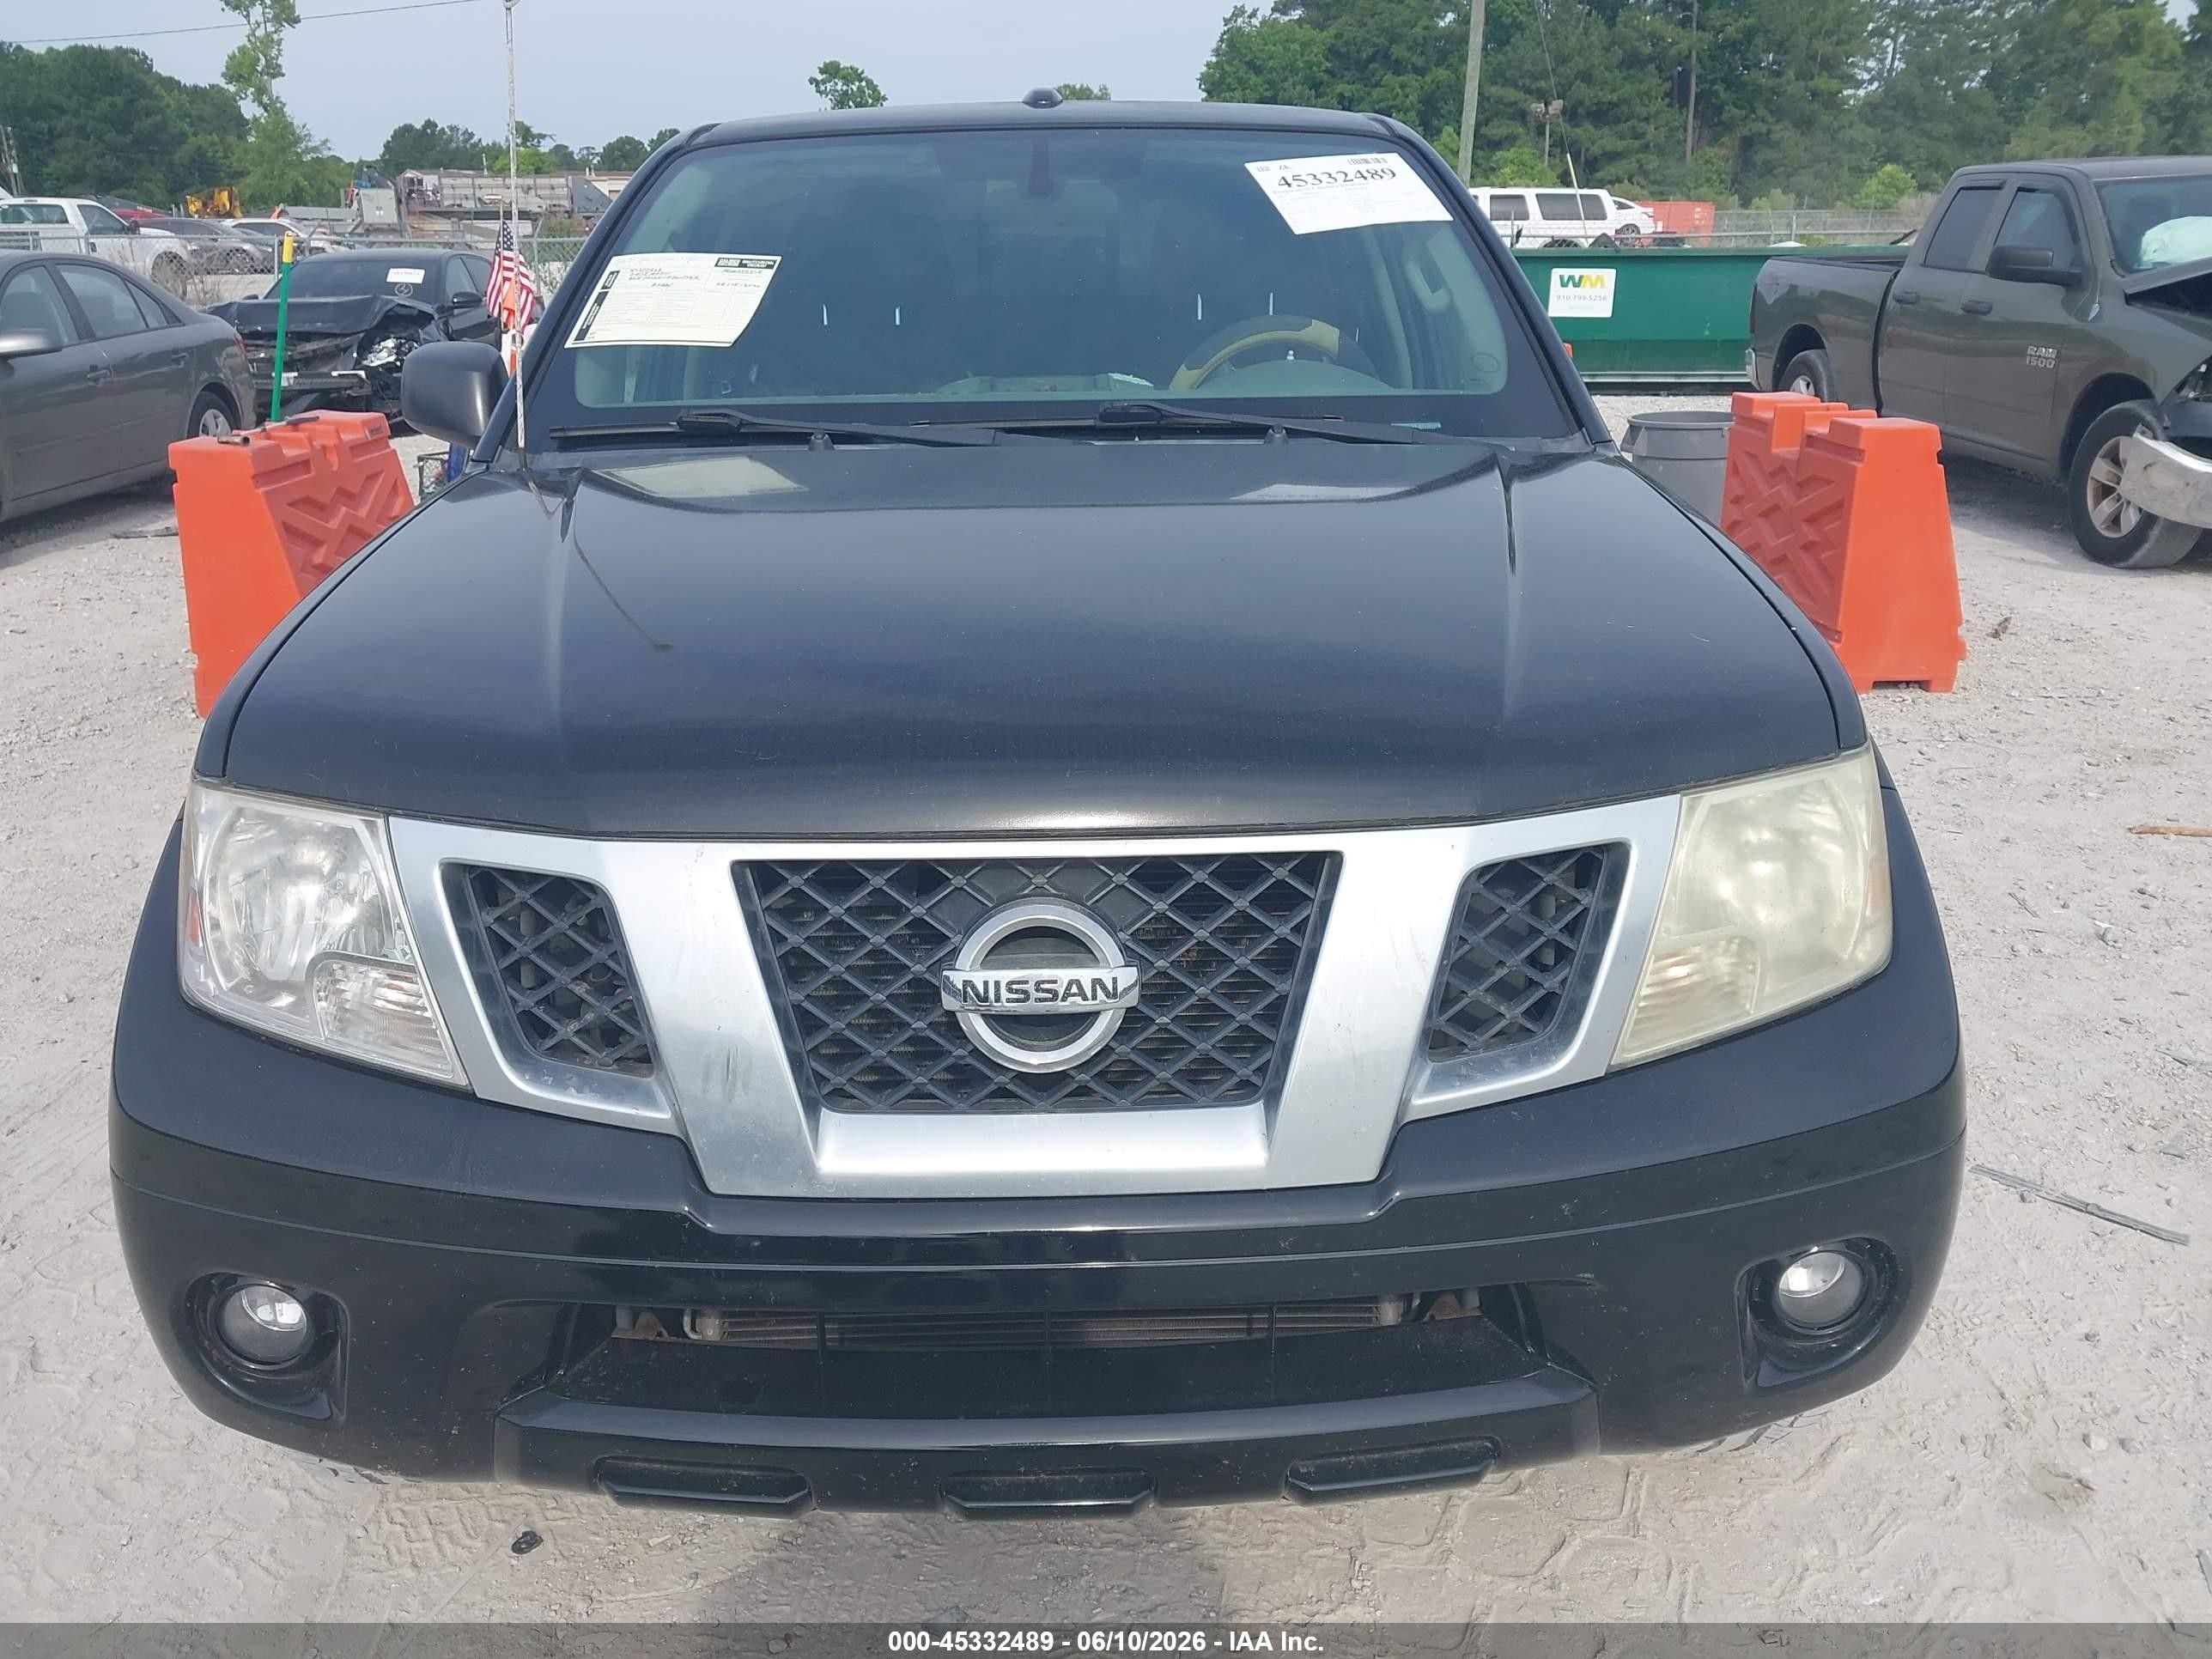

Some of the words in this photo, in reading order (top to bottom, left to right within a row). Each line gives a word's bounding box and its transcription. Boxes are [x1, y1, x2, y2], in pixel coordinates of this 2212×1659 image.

[1278, 167, 1397, 188] 45332489
[1559, 274, 1606, 289] WM
[2027, 345, 2057, 359] RAM
[2026, 356, 2056, 368] 1500
[962, 976, 1120, 1005] NISSAN
